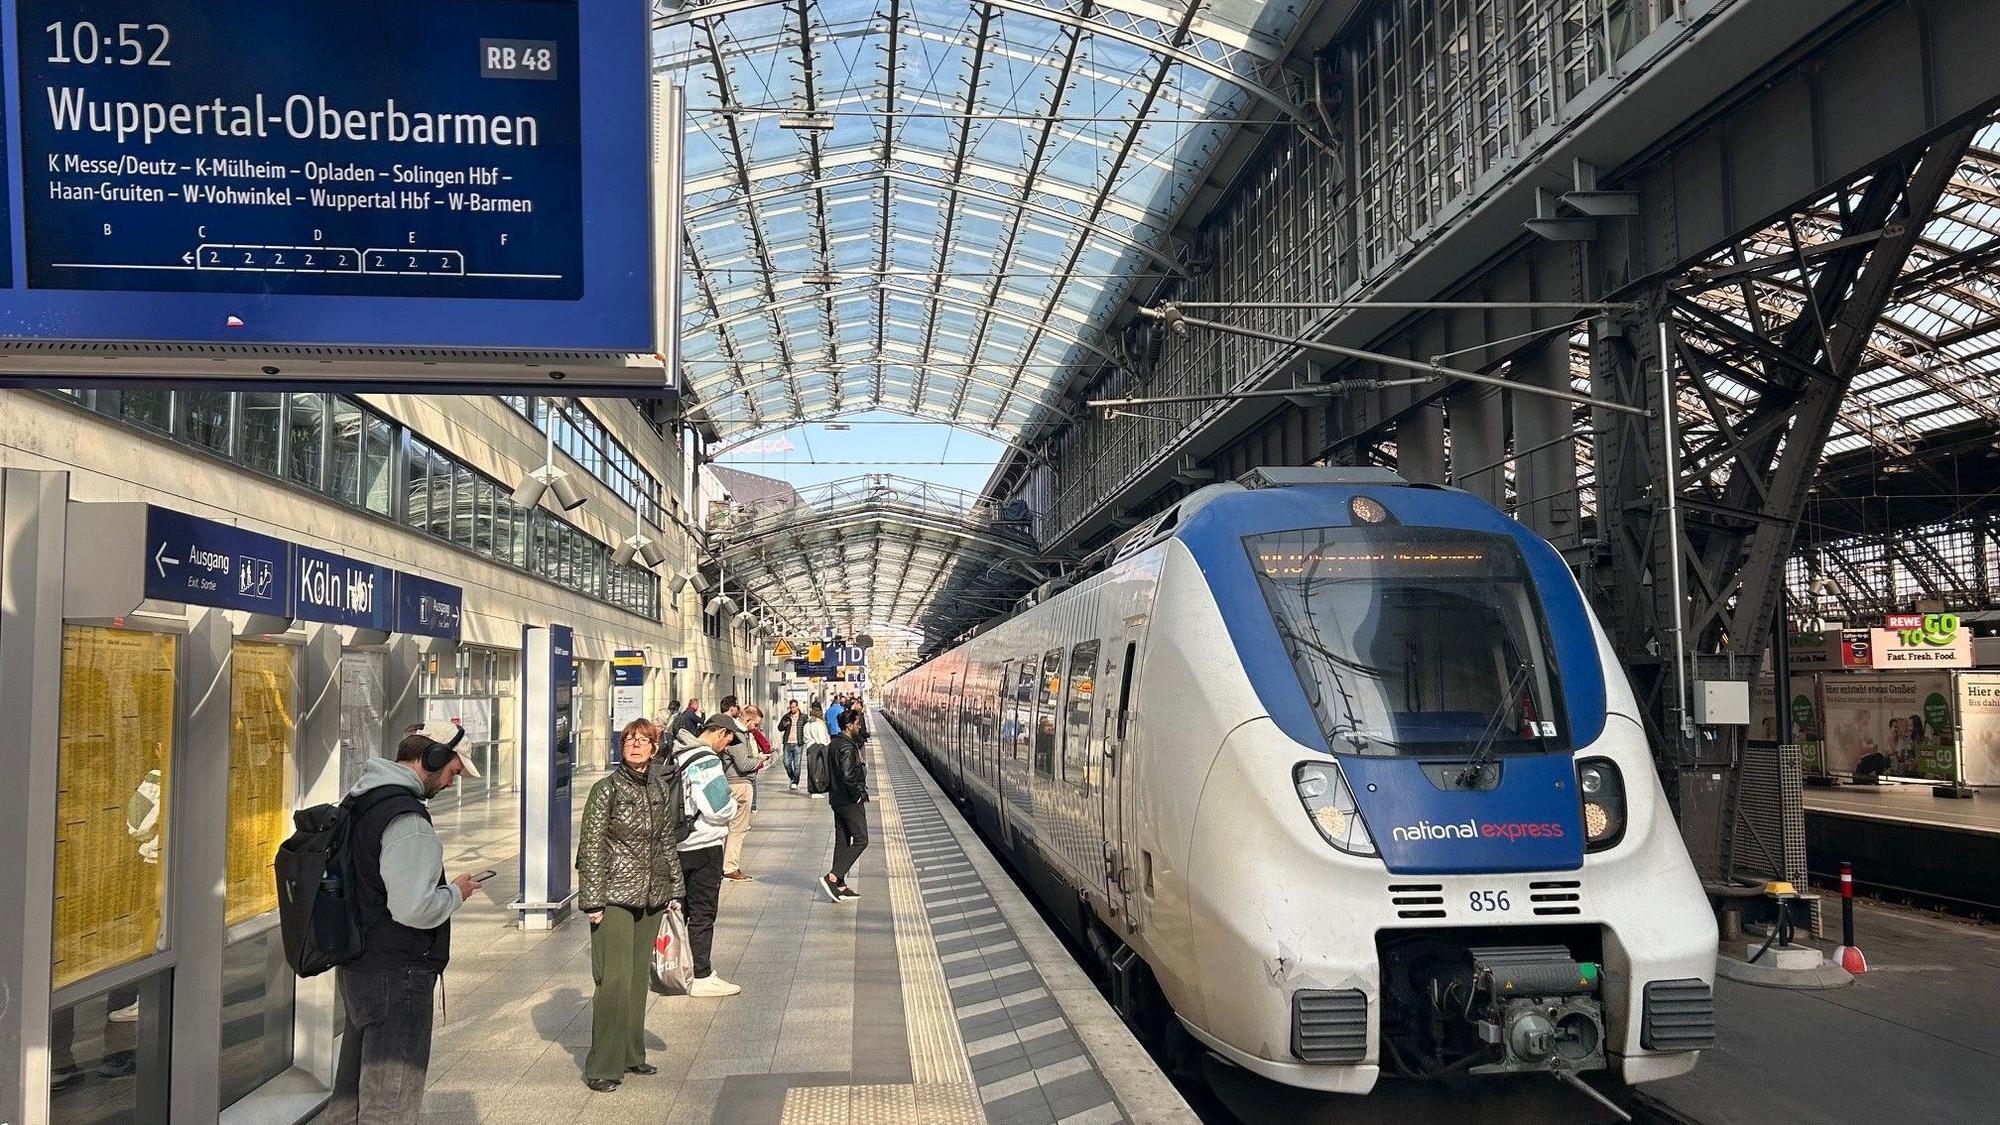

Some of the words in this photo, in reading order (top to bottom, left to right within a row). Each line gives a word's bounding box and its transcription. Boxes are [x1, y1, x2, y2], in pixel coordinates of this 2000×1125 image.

[46, 21, 171, 66] 10:52
[487, 46, 517, 70] RB
[521, 48, 552, 72] 48
[46, 86, 537, 146] Wuppertal-Oberbarmen
[48, 153, 60, 173] K
[64, 153, 177, 176] Messe/Deutz
[195, 157, 286, 179] K-Mülheim
[304, 161, 375, 185] Opladen
[392, 164, 465, 189] Solingen
[469, 166, 499, 186] Hbf
[49, 180, 164, 202] Haan-Gruiten
[182, 184, 293, 206] W-Vohwinkel
[310, 188, 397, 212] Wuppertal
[400, 190, 431, 210] Hbf
[448, 192, 532, 213] W-Barmen
[103, 223, 112, 236] B
[198, 225, 206, 238] C
[314, 228, 322, 241] D
[408, 231, 416, 244] E
[501, 233, 508, 246] F
[189, 544, 229, 575] Ausgang
[301, 557, 341, 607] Köln
[1889, 616, 1921, 627] REWE
[1923, 613, 1956, 635] GO
[1898, 630, 1922, 646] TO
[835, 647, 842, 662] 1
[851, 647, 863, 662] D
[1887, 653, 1907, 661] Fast.
[1908, 652, 1933, 661] Fresh.
[1934, 652, 1957, 660] Food.
[1967, 686, 1991, 696] Hier
[1392, 819, 1479, 841] national
[1481, 822, 1564, 842] express
[1469, 890, 1511, 911] 856
